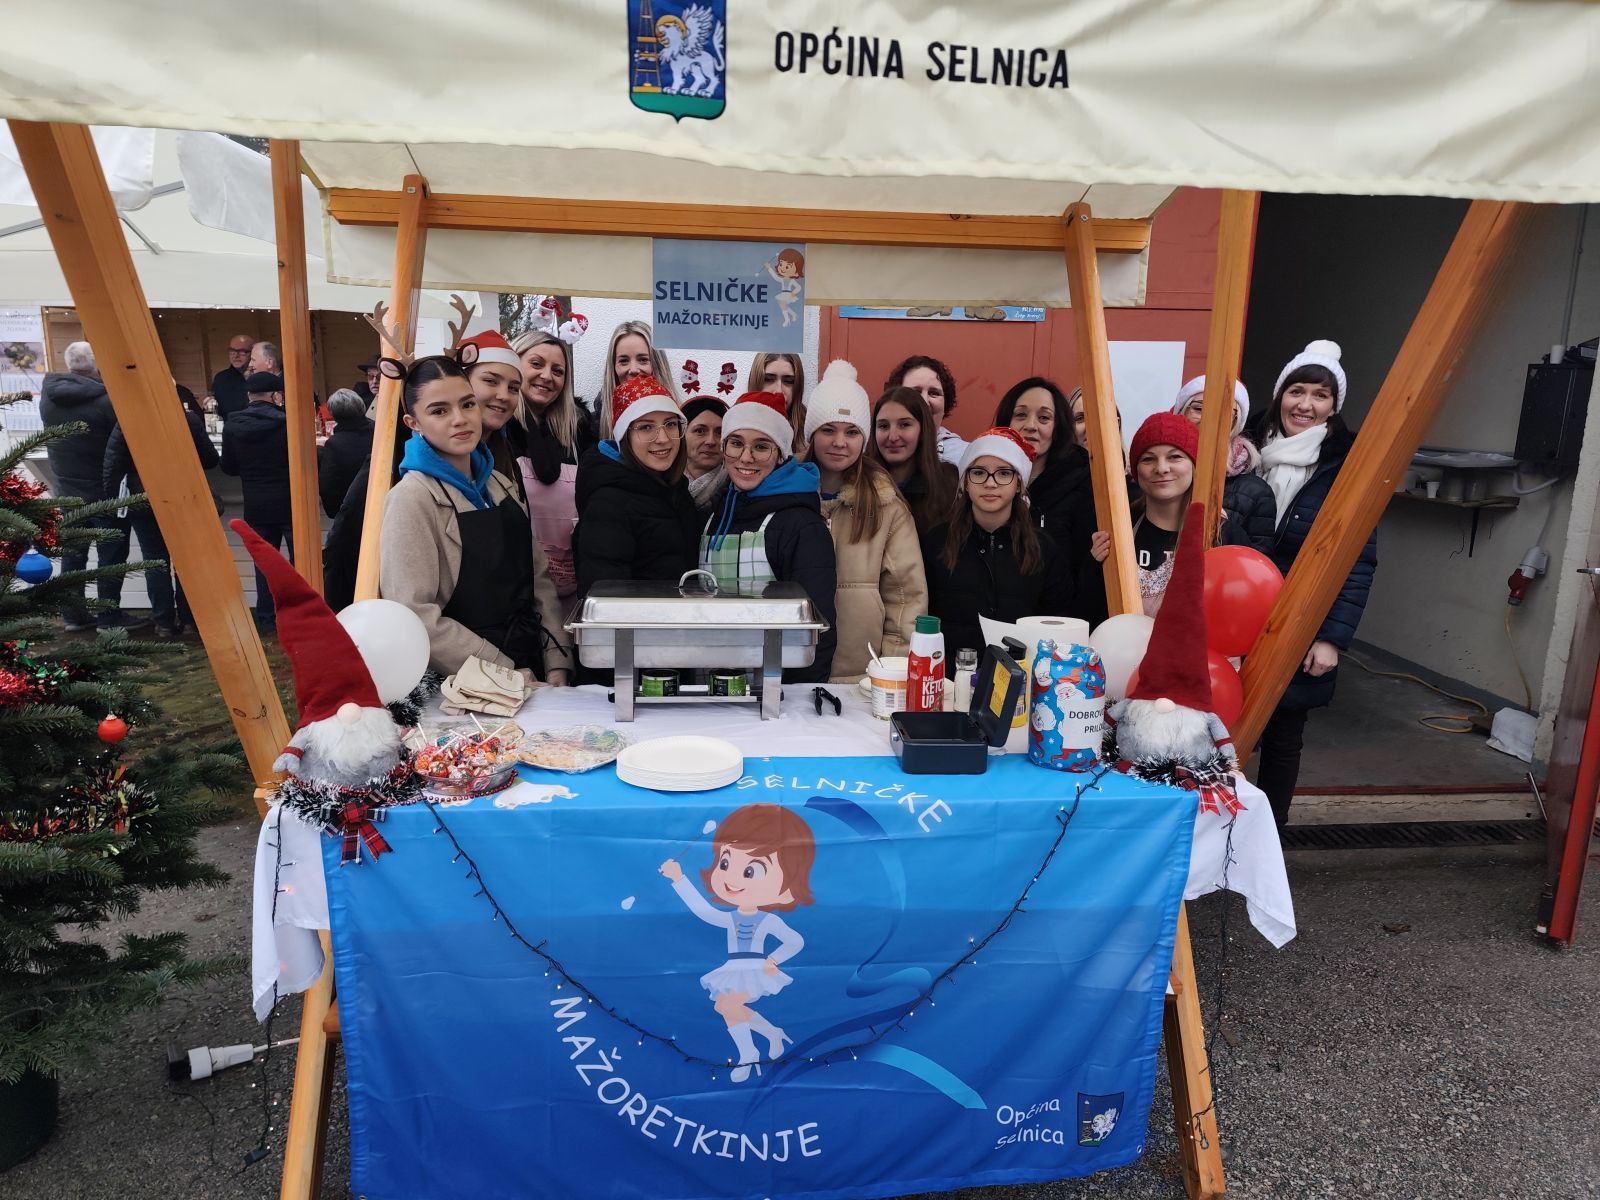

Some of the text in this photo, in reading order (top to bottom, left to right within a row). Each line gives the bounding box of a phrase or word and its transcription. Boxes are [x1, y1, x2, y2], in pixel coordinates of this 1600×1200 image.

[775, 26, 1069, 88] OPĆINA SELNICA
[655, 277, 768, 303] SELNIČKE
[657, 309, 769, 330] MAŽORETKINJE
[921, 695, 935, 709] UP
[736, 774, 952, 833] SELNIČKE
[550, 996, 822, 1162] MAŽORETKINJE
[996, 1098, 1060, 1128] Općina
